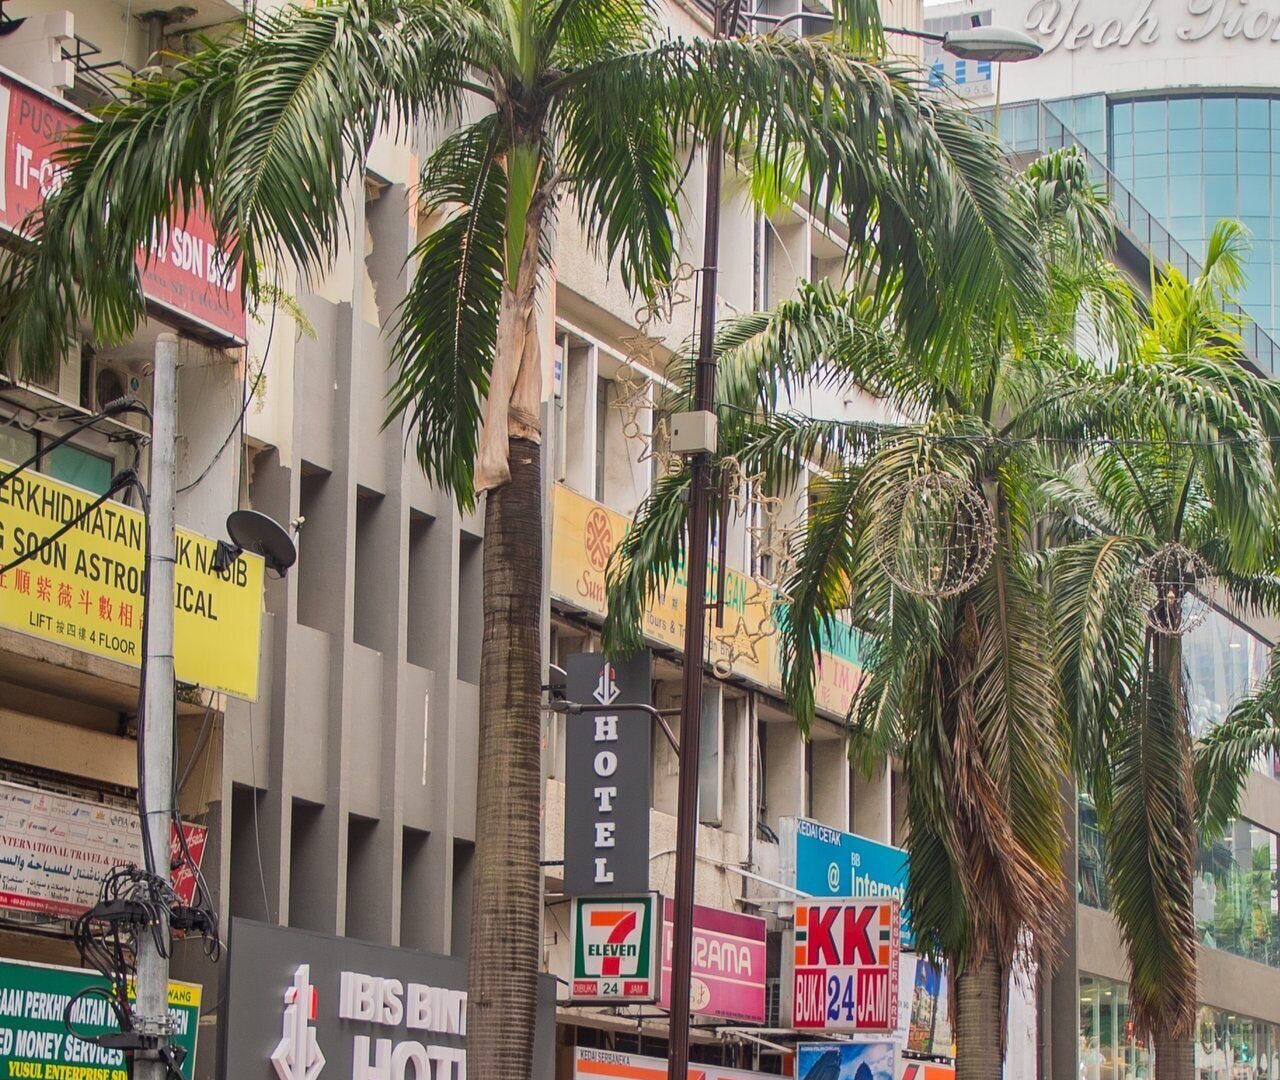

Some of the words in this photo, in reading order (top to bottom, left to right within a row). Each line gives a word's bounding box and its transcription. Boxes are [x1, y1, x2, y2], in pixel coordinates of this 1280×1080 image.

[13, 527, 67, 570] SOON
[29, 611, 52, 631] LIFT
[89, 628, 96, 643] 4
[99, 632, 136, 657] FLOOR
[593, 715, 618, 884] HOTEL
[797, 820, 818, 838] KEDAI
[819, 826, 841, 847] CETAK
[71, 849, 102, 864] TRAVEL
[851, 852, 860, 867] BB
[807, 906, 878, 966] KK
[339, 971, 403, 1026] IBIS
[574, 982, 597, 994] DIBUKA
[603, 982, 618, 995] 24
[629, 984, 644, 994] JAM
[796, 974, 824, 1022] BUKA
[827, 975, 854, 1021] 24
[858, 974, 887, 1022] JAM
[15, 1030, 63, 1061] MONEY
[64, 1037, 123, 1066] SERVICES
[580, 1049, 597, 1062] KEDAI
[9, 1060, 44, 1079] YUSUL
